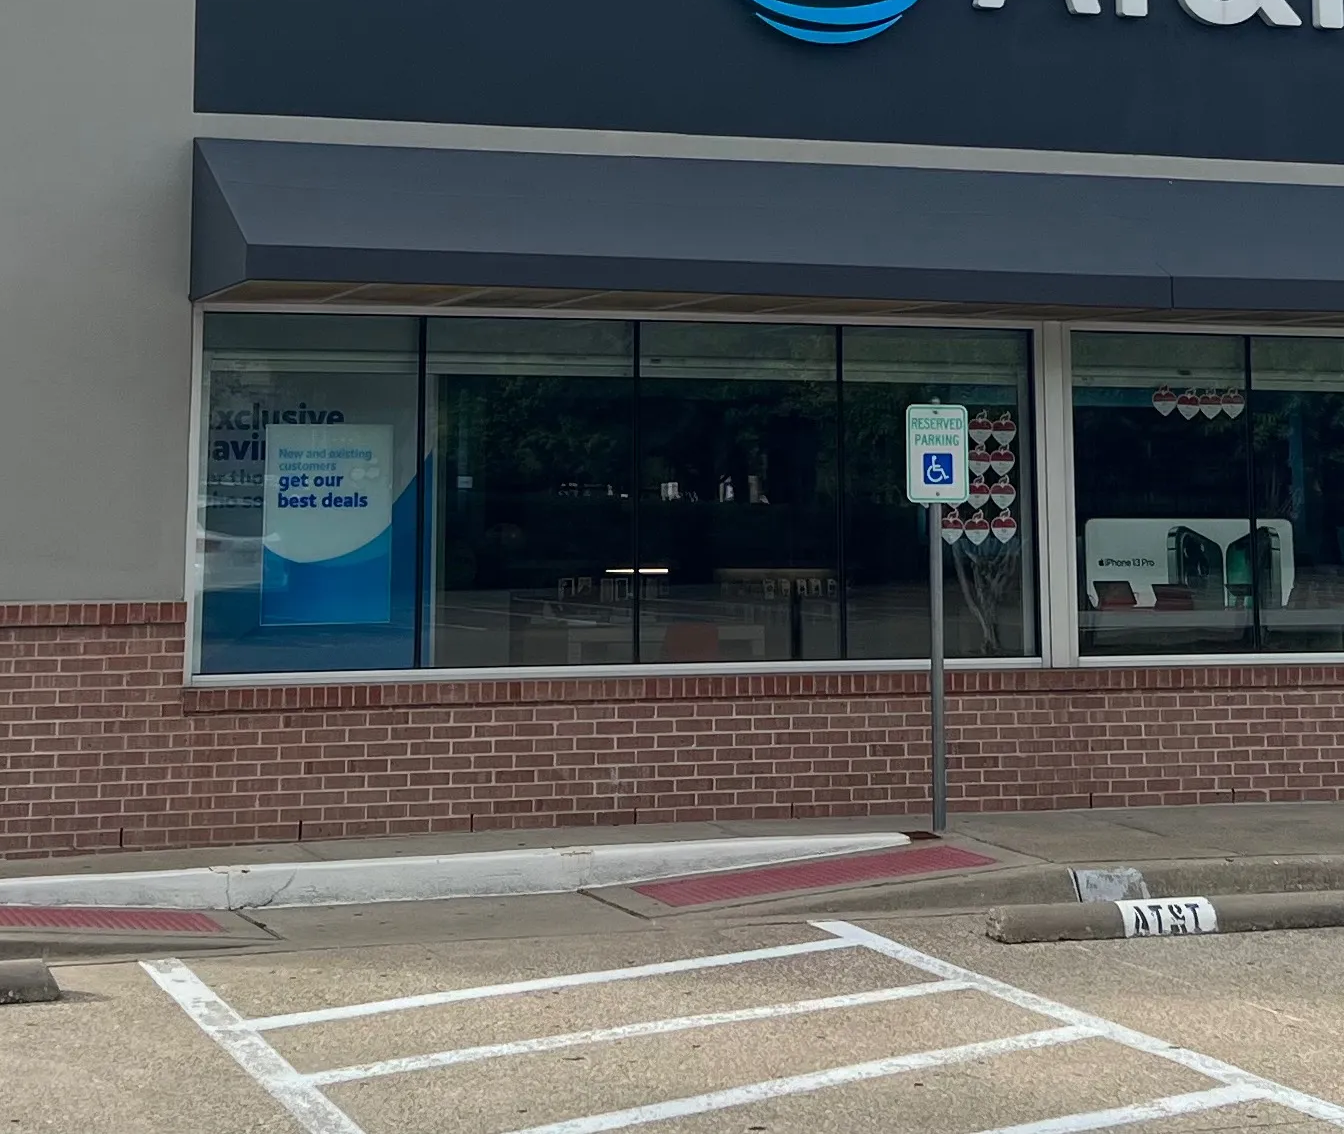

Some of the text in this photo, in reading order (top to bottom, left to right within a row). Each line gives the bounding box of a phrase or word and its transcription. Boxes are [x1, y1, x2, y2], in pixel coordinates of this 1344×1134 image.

[209, 402, 345, 431] xclusive
[911, 417, 963, 430] RESERVED
[207, 432, 266, 461] avi
[914, 433, 960, 447] PARKING
[278, 448, 372, 462] New and existing
[278, 461, 336, 472] customers
[278, 473, 344, 492] get our
[277, 492, 317, 508] best
[321, 492, 368, 509] deals
[1105, 558, 1132, 567] iPhone
[1141, 558, 1155, 567] Pro
[1133, 902, 1201, 935] AT&T
